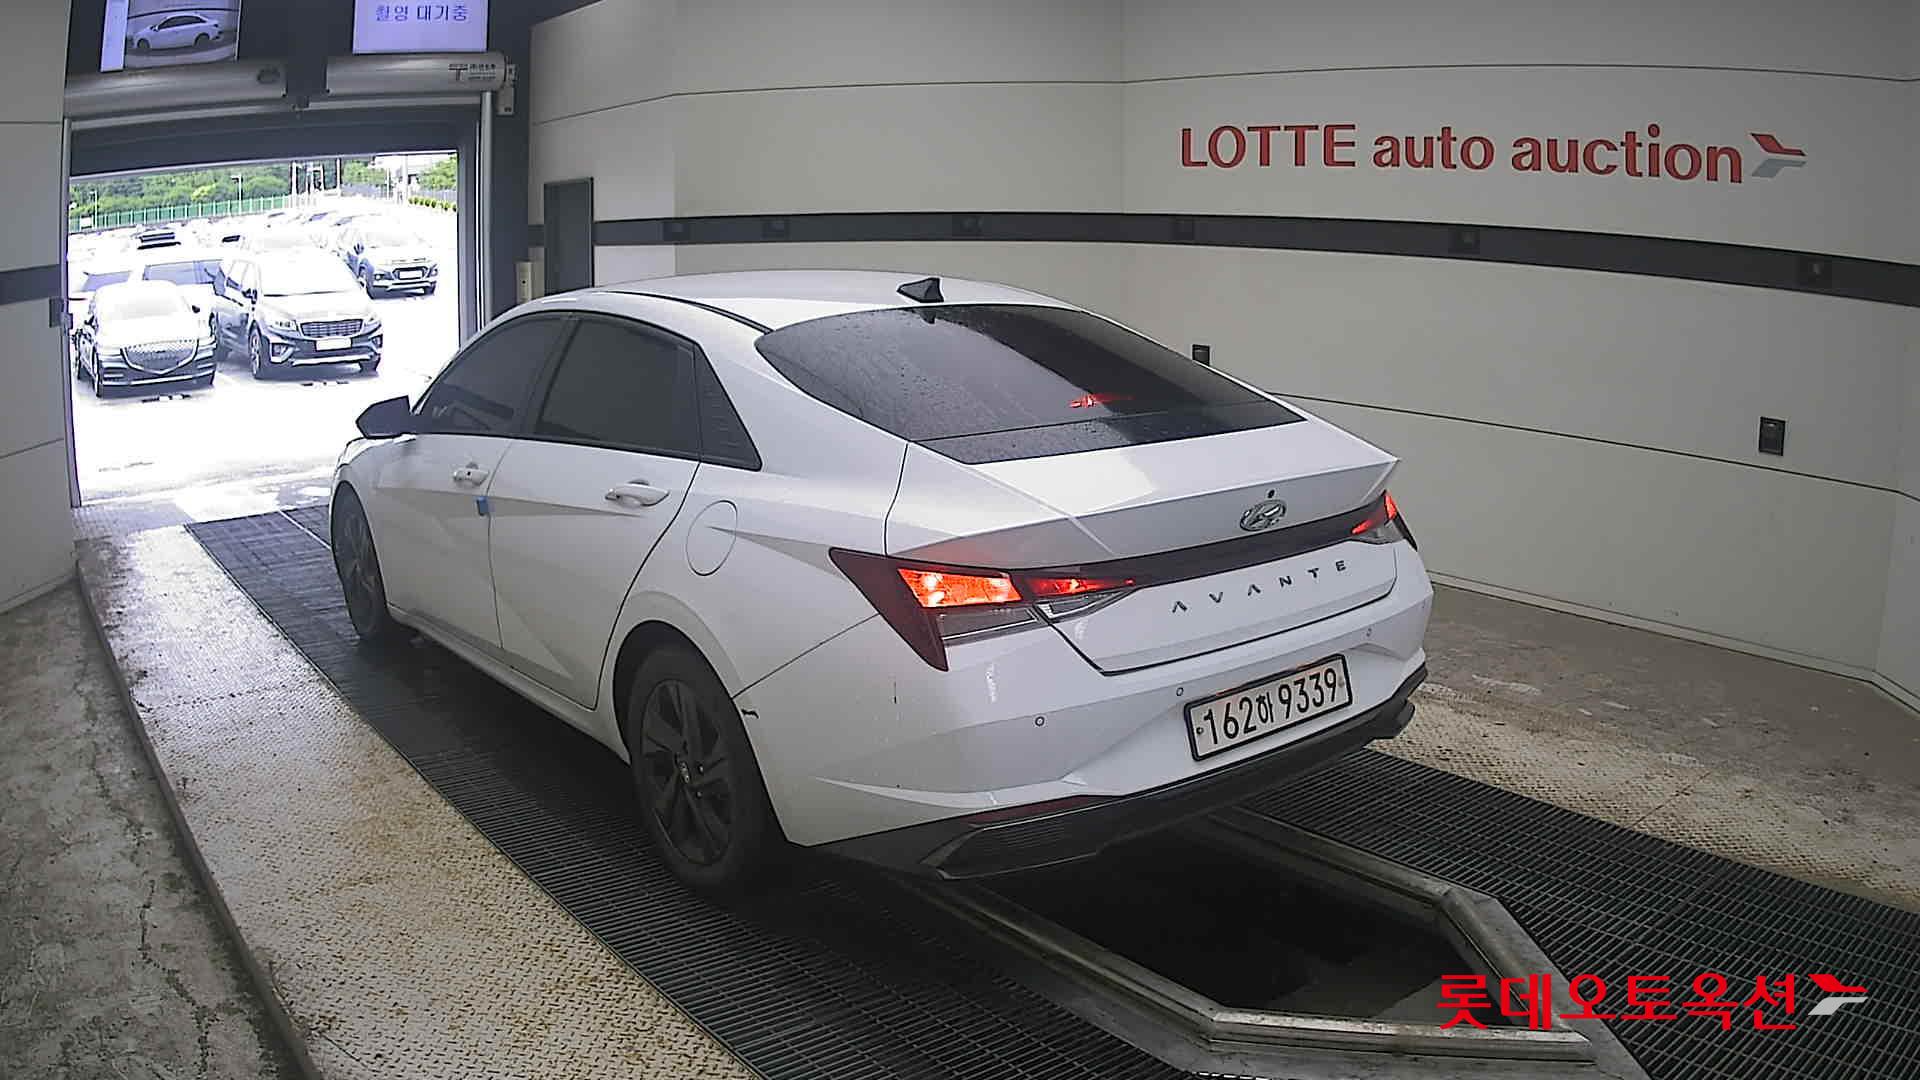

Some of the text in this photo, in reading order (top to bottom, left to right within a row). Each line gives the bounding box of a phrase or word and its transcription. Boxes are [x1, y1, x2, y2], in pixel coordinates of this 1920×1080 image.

[417, 5, 467, 21] 대기중
[1180, 124, 1743, 184] LOTTE auto auction
[1172, 560, 1346, 613] AVANTE
